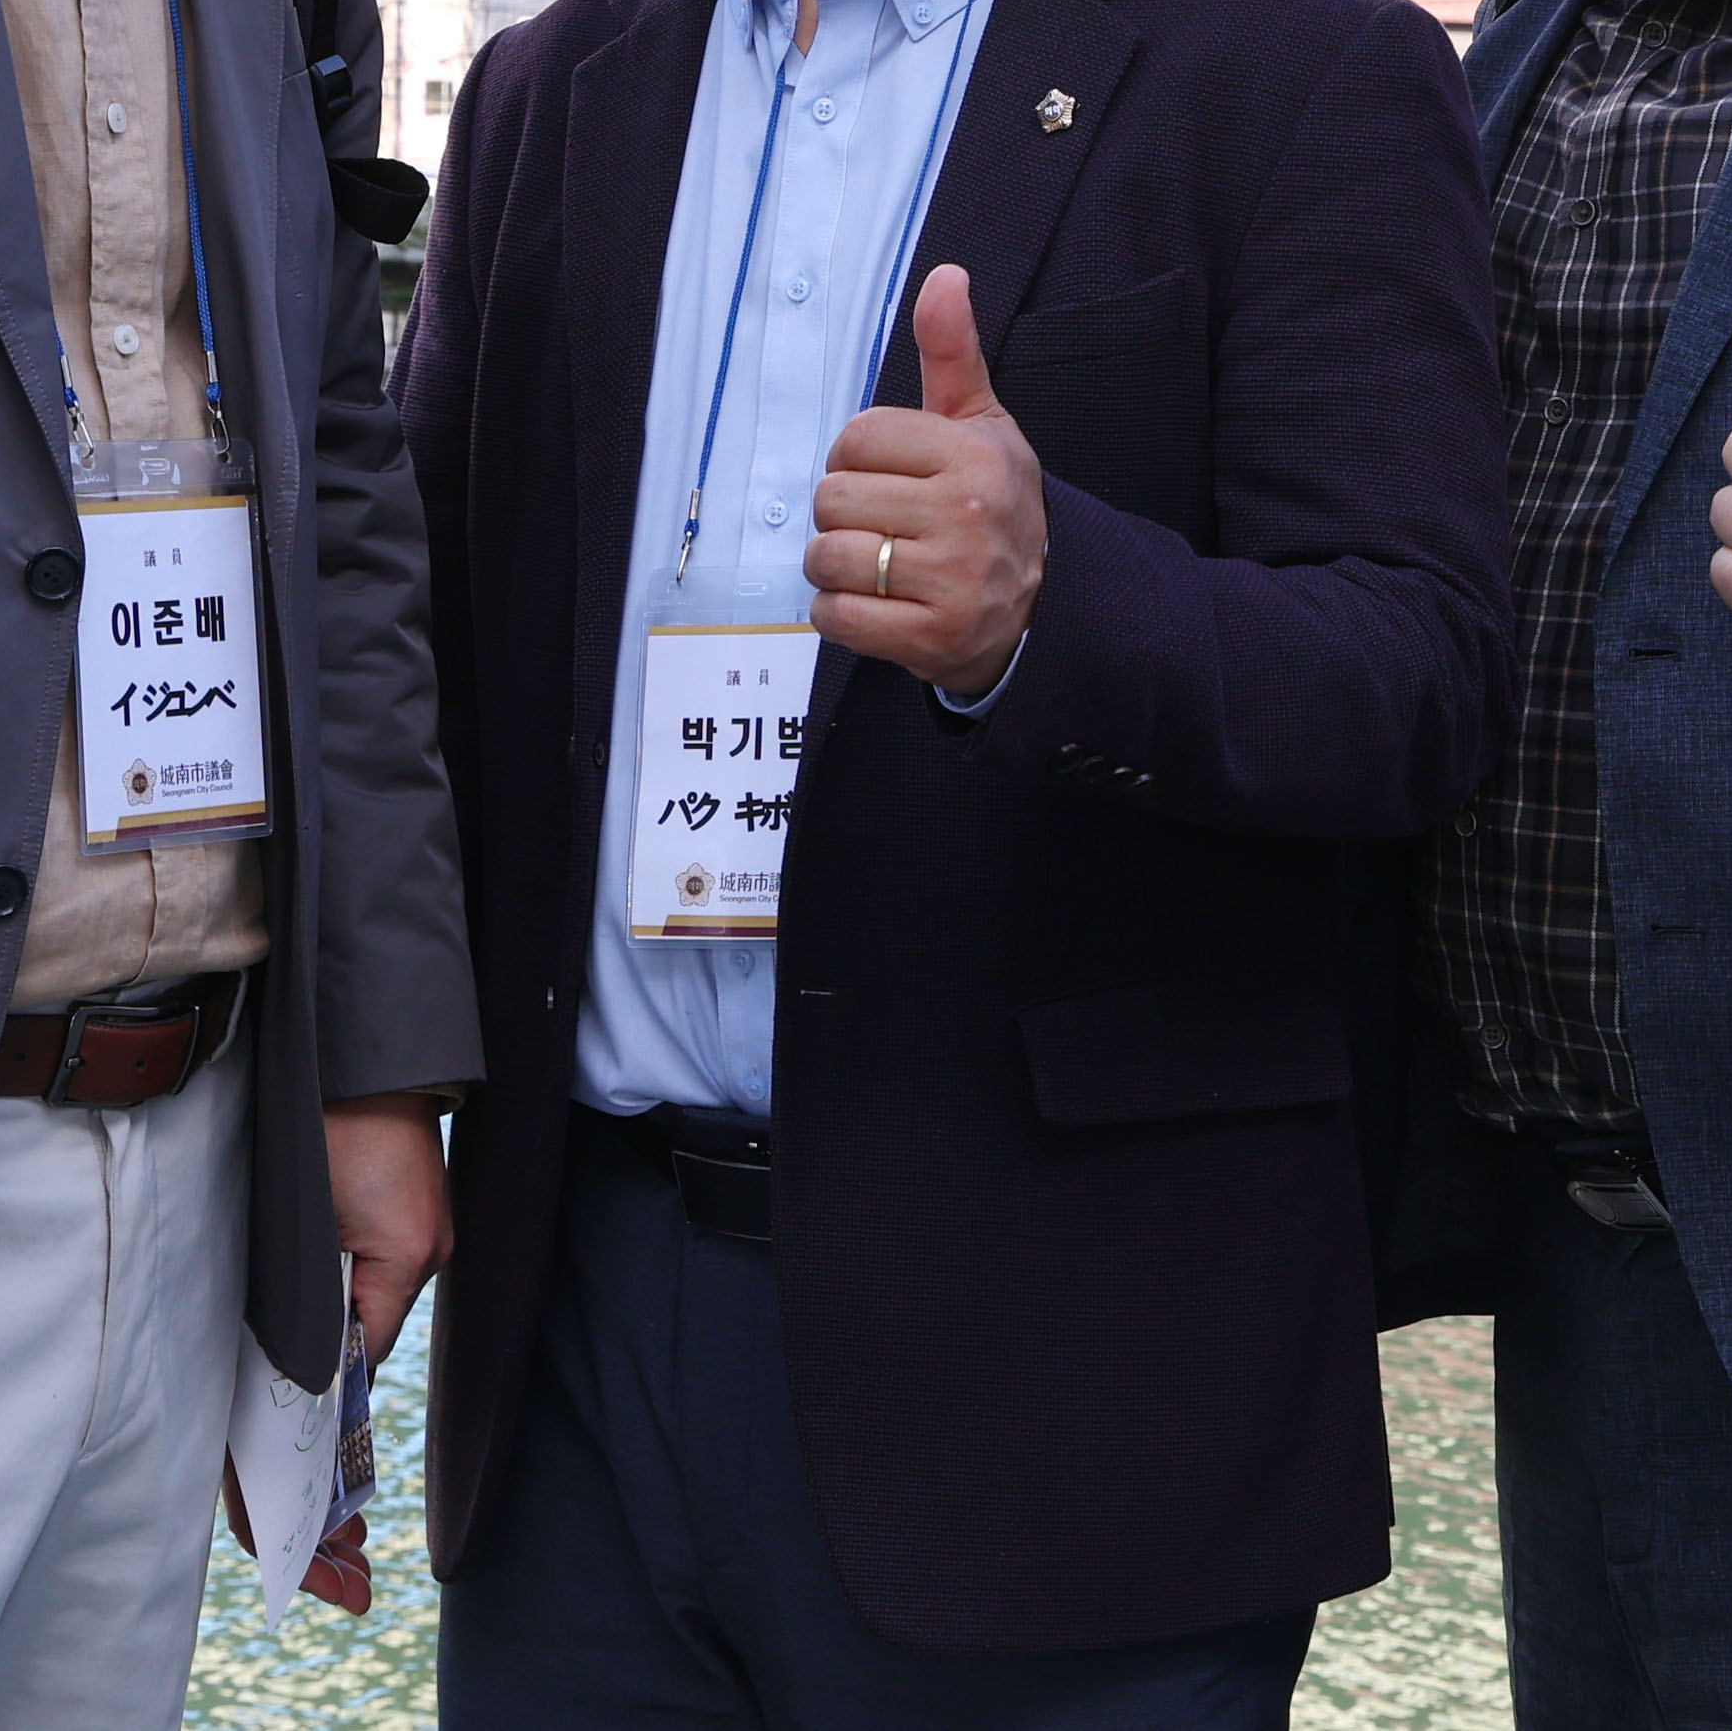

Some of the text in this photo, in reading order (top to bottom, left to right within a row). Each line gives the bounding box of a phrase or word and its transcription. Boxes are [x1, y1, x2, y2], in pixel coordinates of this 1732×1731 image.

[161, 782, 233, 798] Seongnam City Council
[657, 791, 721, 831] パク
[719, 894, 757, 904] Seongnam
[757, 894, 771, 904] City
